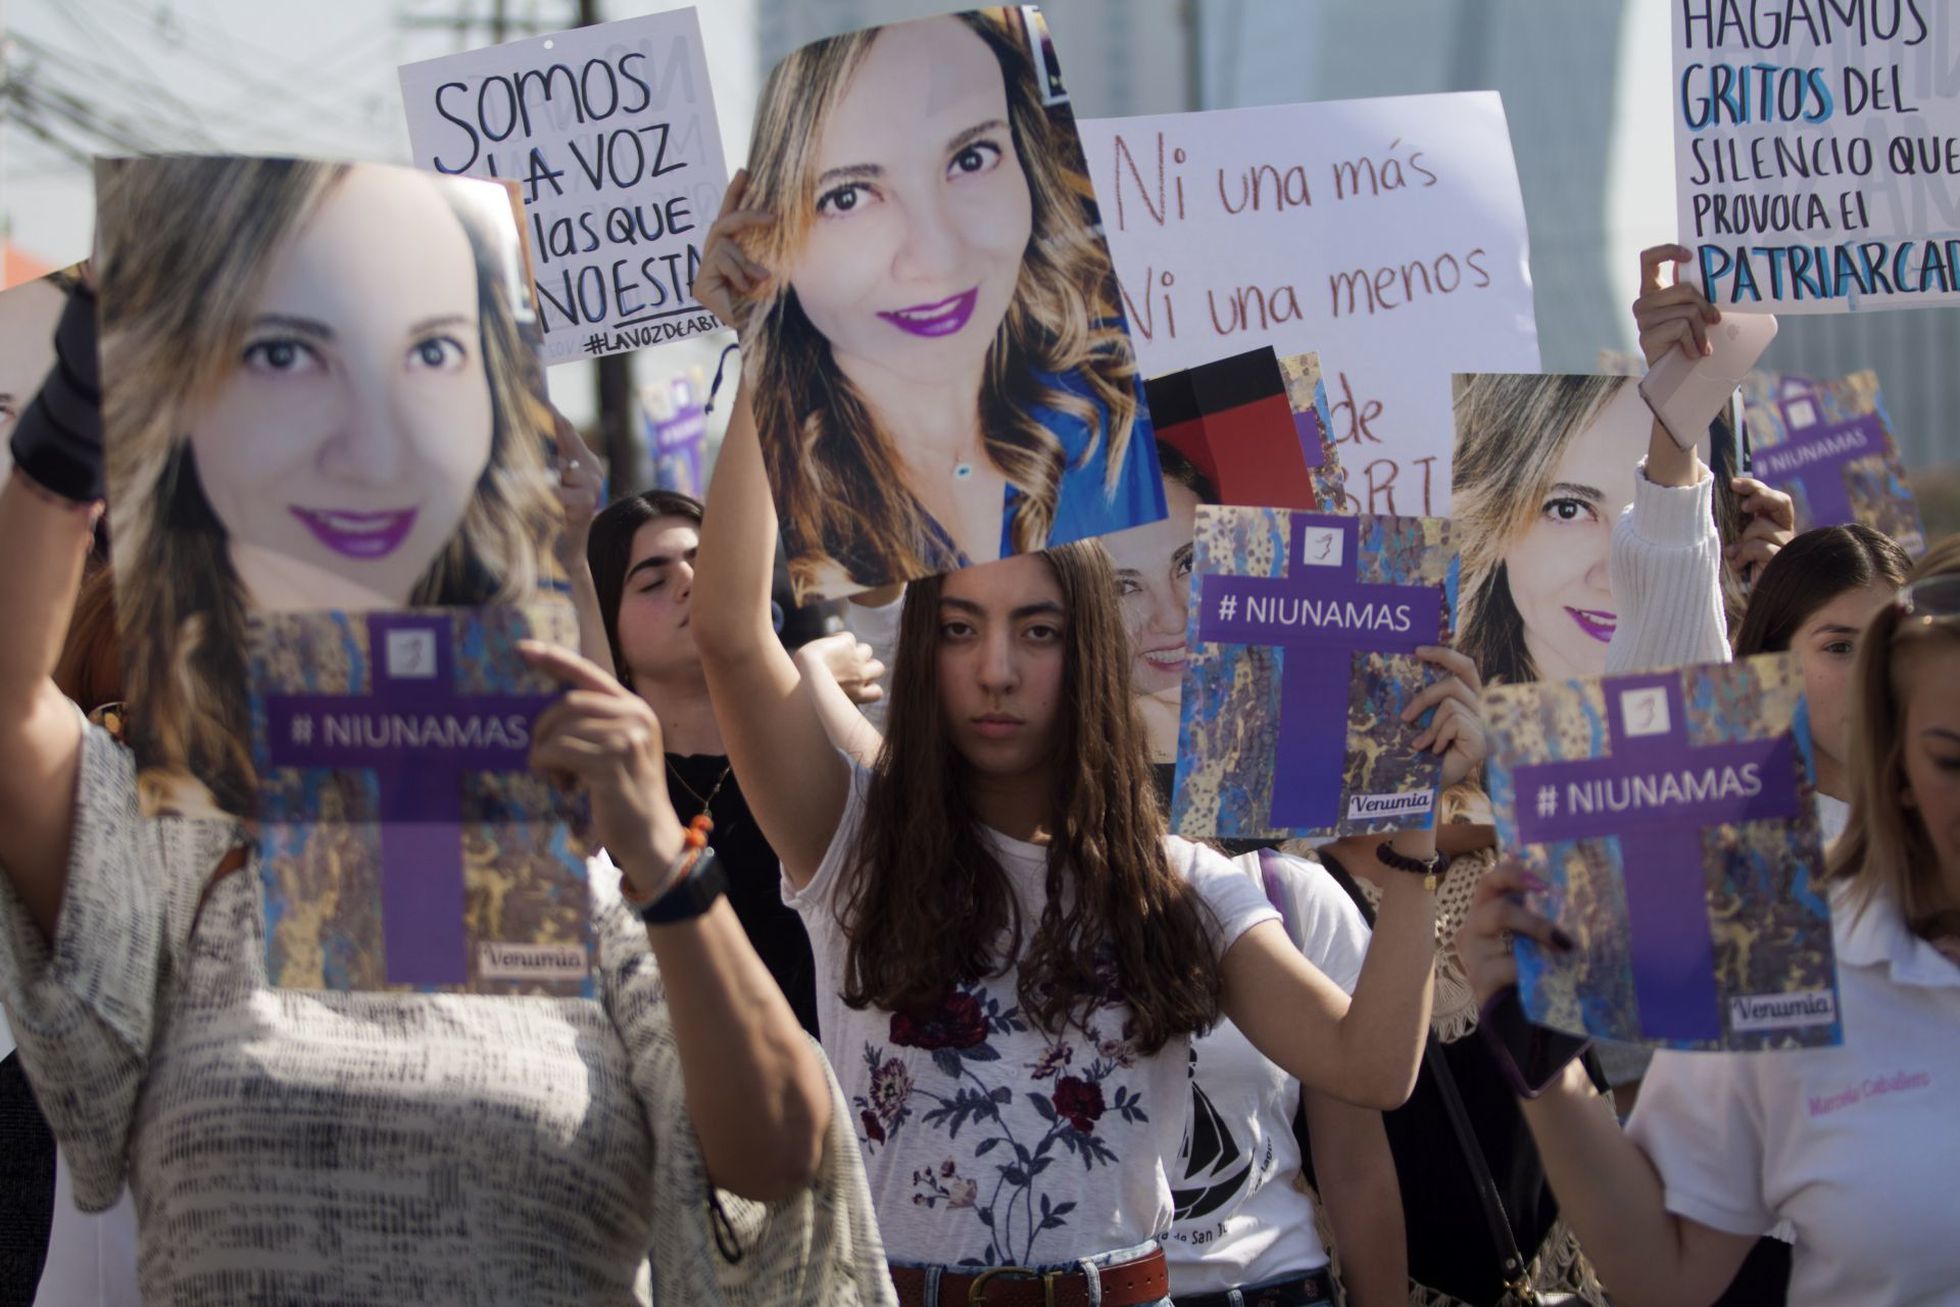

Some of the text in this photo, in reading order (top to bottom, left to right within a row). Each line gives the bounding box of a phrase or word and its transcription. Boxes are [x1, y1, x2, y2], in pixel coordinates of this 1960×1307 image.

[1682, 0, 1928, 49] HAGAMOS
[1681, 61, 1919, 132] GRITOS DEL
[568, 123, 688, 191] VOZ
[1114, 131, 1438, 231] Ni una más
[1690, 135, 1960, 186] SILENCIO QUE
[1693, 193, 1831, 237] PROVOCA
[1207, 285, 1303, 336] una
[1329, 248, 1490, 318] menos
[1697, 240, 1960, 304] PATRIARCAD
[1331, 372, 1384, 444] de
[1771, 427, 1868, 473] NIUNAMAS
[1218, 594, 1411, 632] # NIUNAMAS
[323, 714, 529, 748] NIUNAMAS
[1351, 792, 1429, 812] Venumia
[1536, 763, 1762, 818] # NIUNAMAS
[485, 942, 581, 969] Venumia
[1731, 994, 1832, 1020] Venumia
[1192, 1230, 1212, 1245] San
